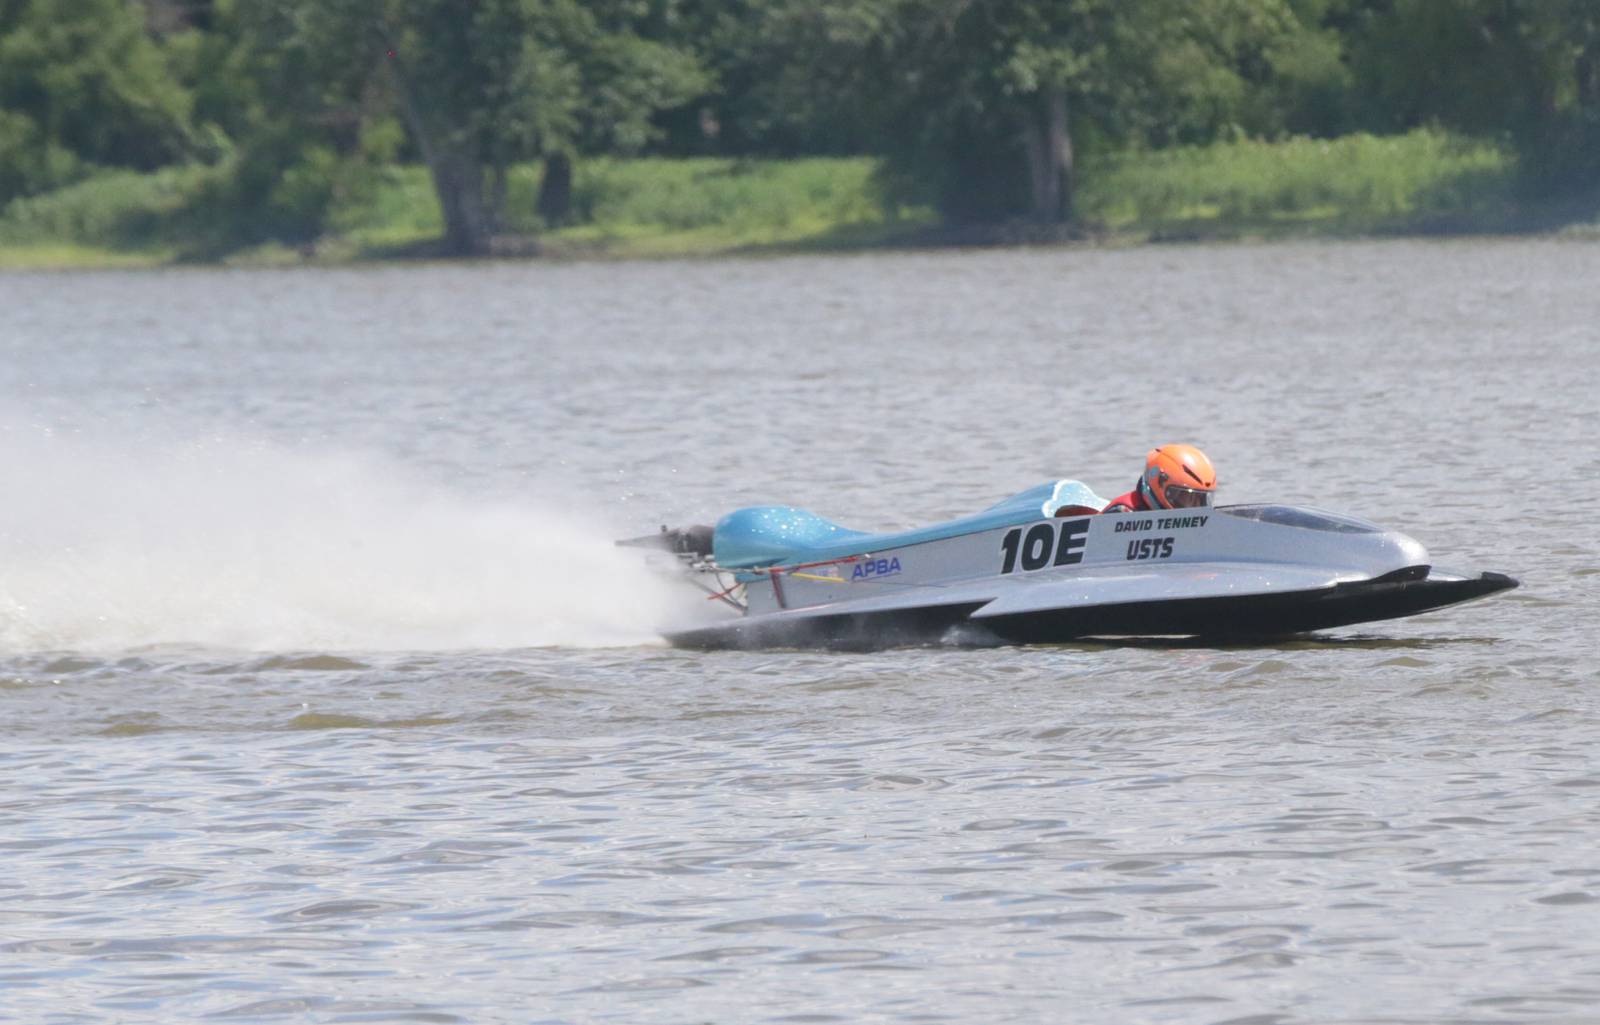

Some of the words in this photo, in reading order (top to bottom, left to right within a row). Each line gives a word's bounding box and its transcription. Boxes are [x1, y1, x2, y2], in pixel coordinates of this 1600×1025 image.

[1115, 519, 1152, 533] DAVID
[1157, 516, 1208, 530] TENNEY
[1001, 519, 1090, 574] 10E
[1126, 537, 1174, 560] USTS
[852, 557, 901, 580] APBA
